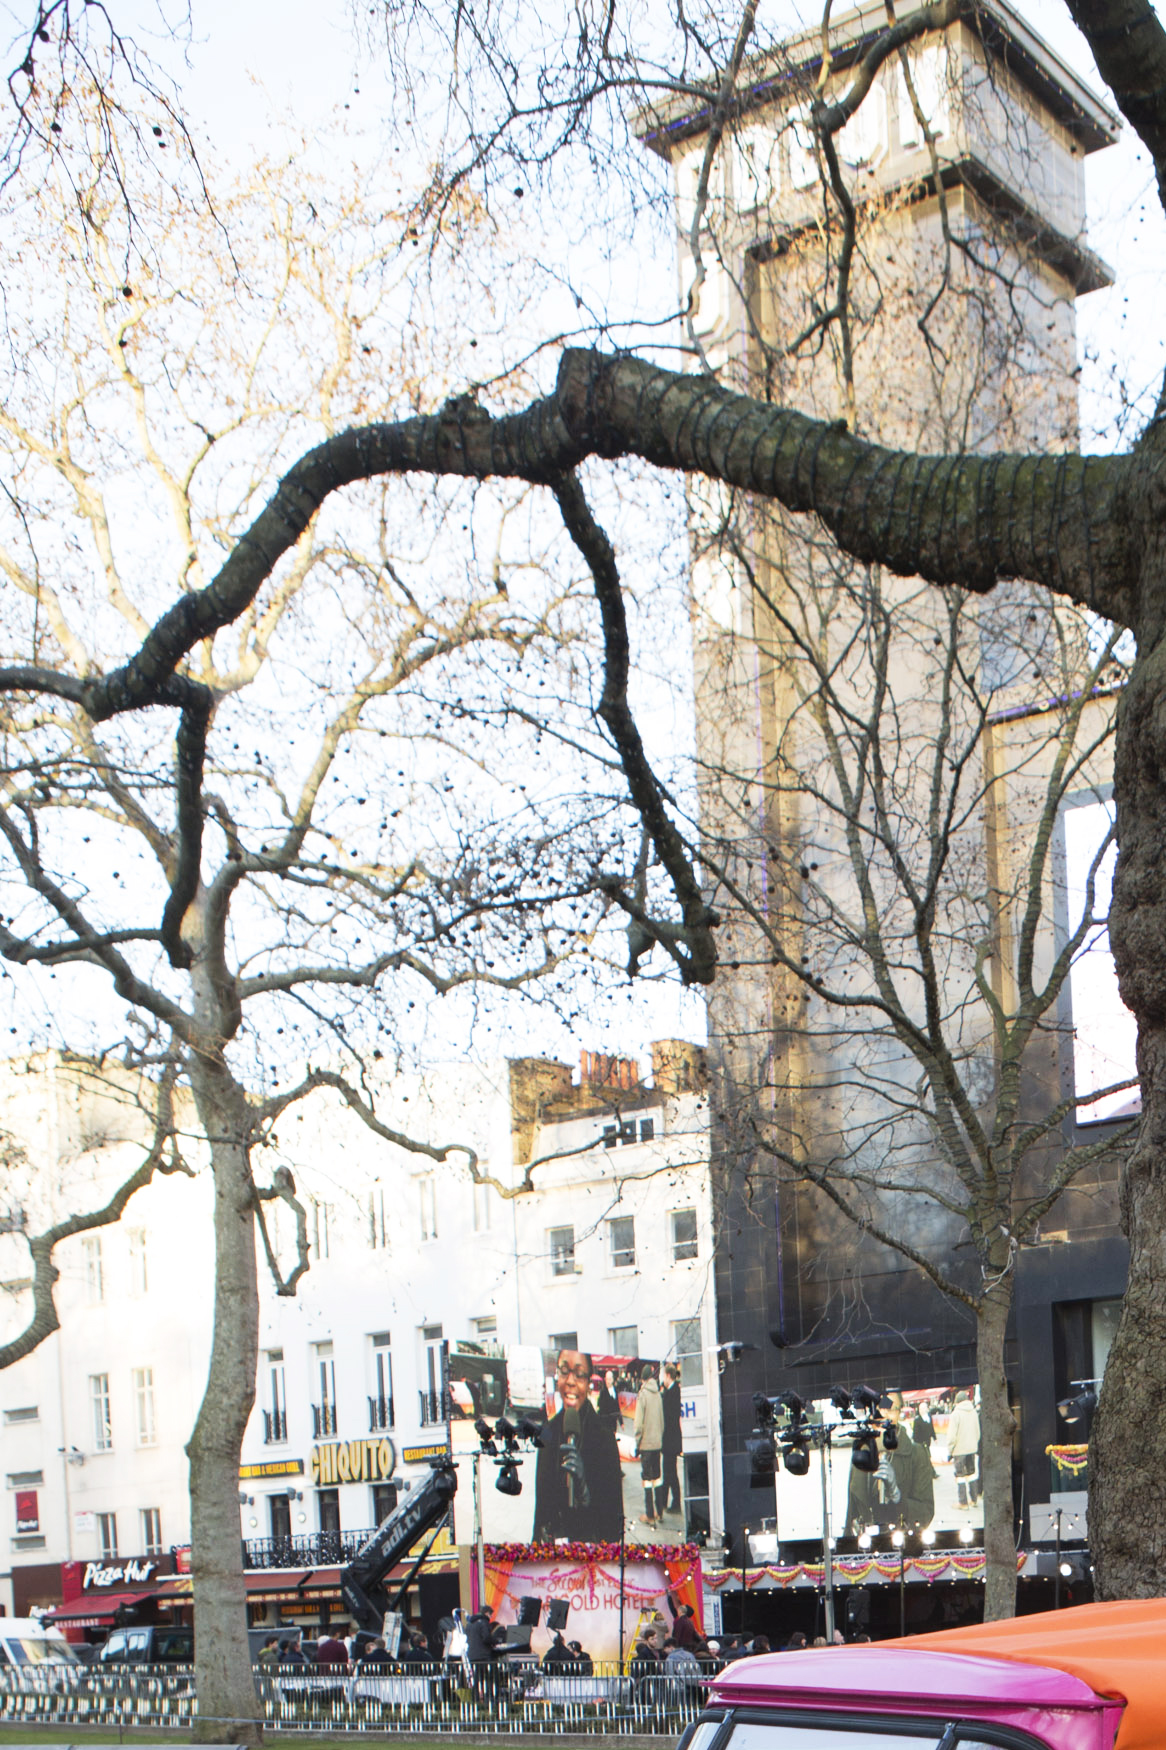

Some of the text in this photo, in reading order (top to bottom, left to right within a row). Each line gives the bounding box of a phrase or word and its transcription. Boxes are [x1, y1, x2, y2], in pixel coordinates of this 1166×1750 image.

[310, 1437, 396, 1485] CHIQUITO
[381, 1504, 421, 1558] adi.tv
[83, 1562, 123, 1589] Pizza
[123, 1560, 155, 1584] Hut
[54, 1618, 99, 1628] RESTAURANT
